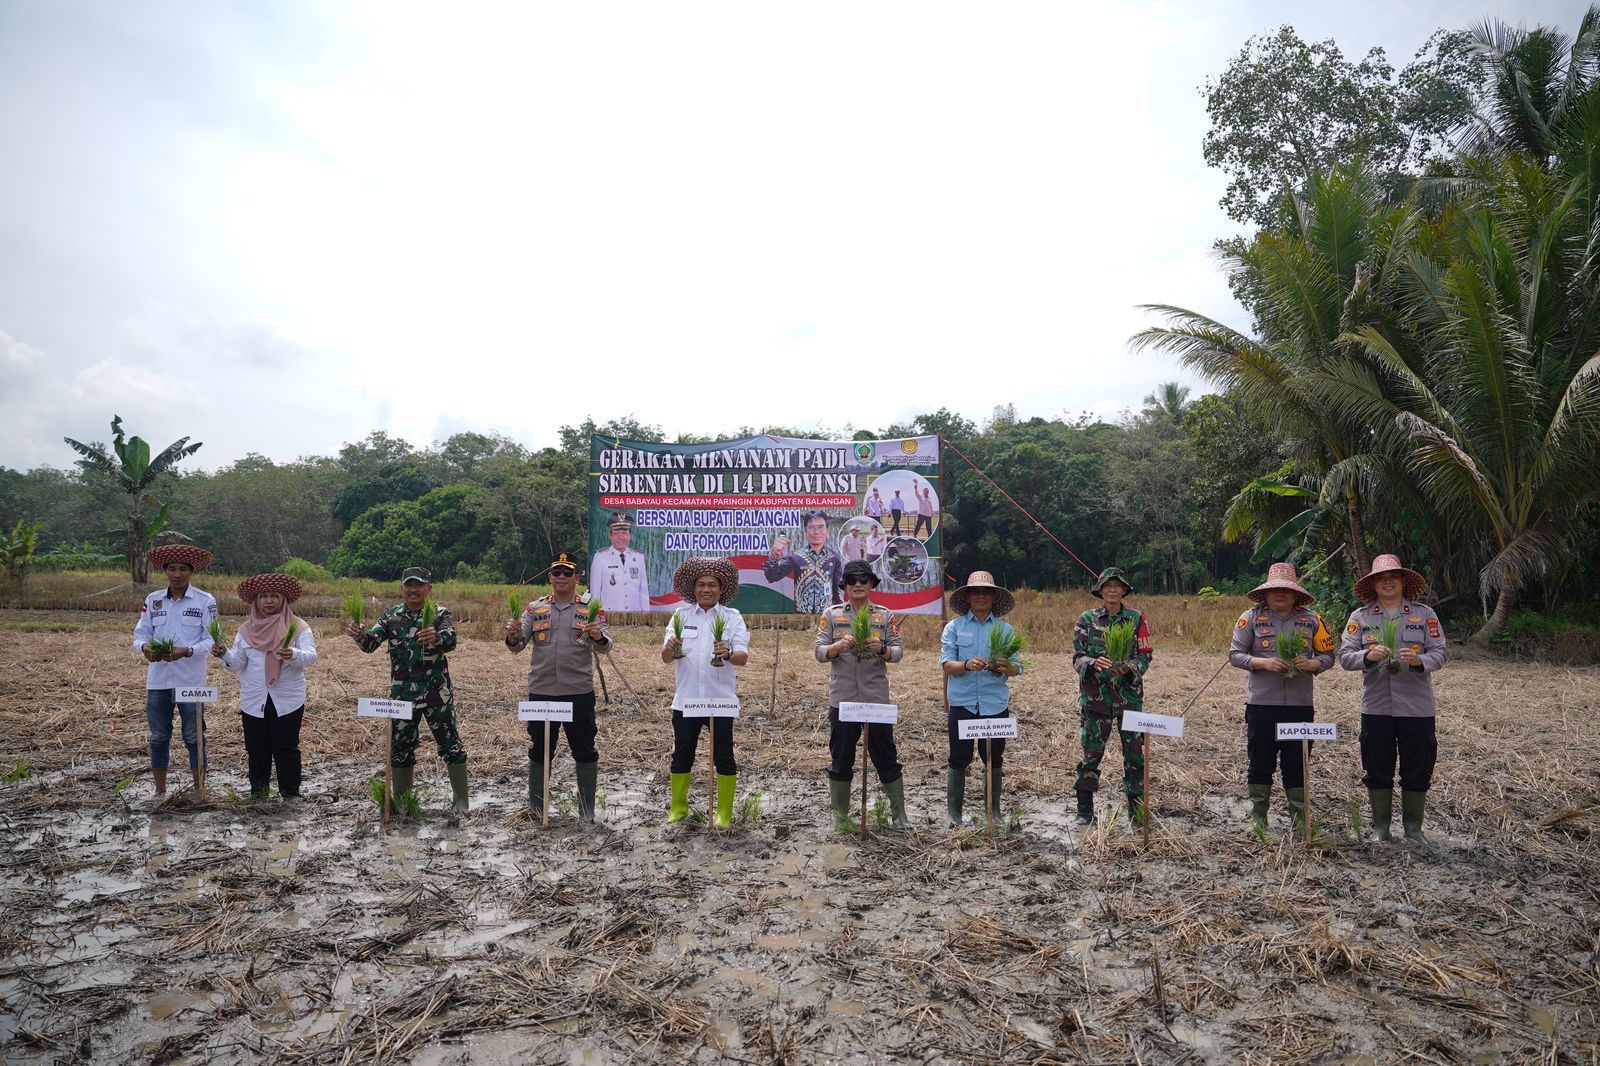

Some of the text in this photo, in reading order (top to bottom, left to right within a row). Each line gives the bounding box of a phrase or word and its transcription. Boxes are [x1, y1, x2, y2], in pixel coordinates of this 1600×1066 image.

[600, 449, 847, 469] GERAKAN MENANAM PADI
[599, 473, 858, 494] SERENTAK DI 14 PROVINSI
[604, 497, 625, 505] DESA
[637, 510, 800, 527] BERSAMA BUPATI BALANGAN
[666, 533, 768, 551] DAN FORKOPIMDA
[181, 690, 213, 698] CAMAT
[1137, 721, 1168, 730] DANRAMIL
[1279, 727, 1334, 736] KAPOLSEK
